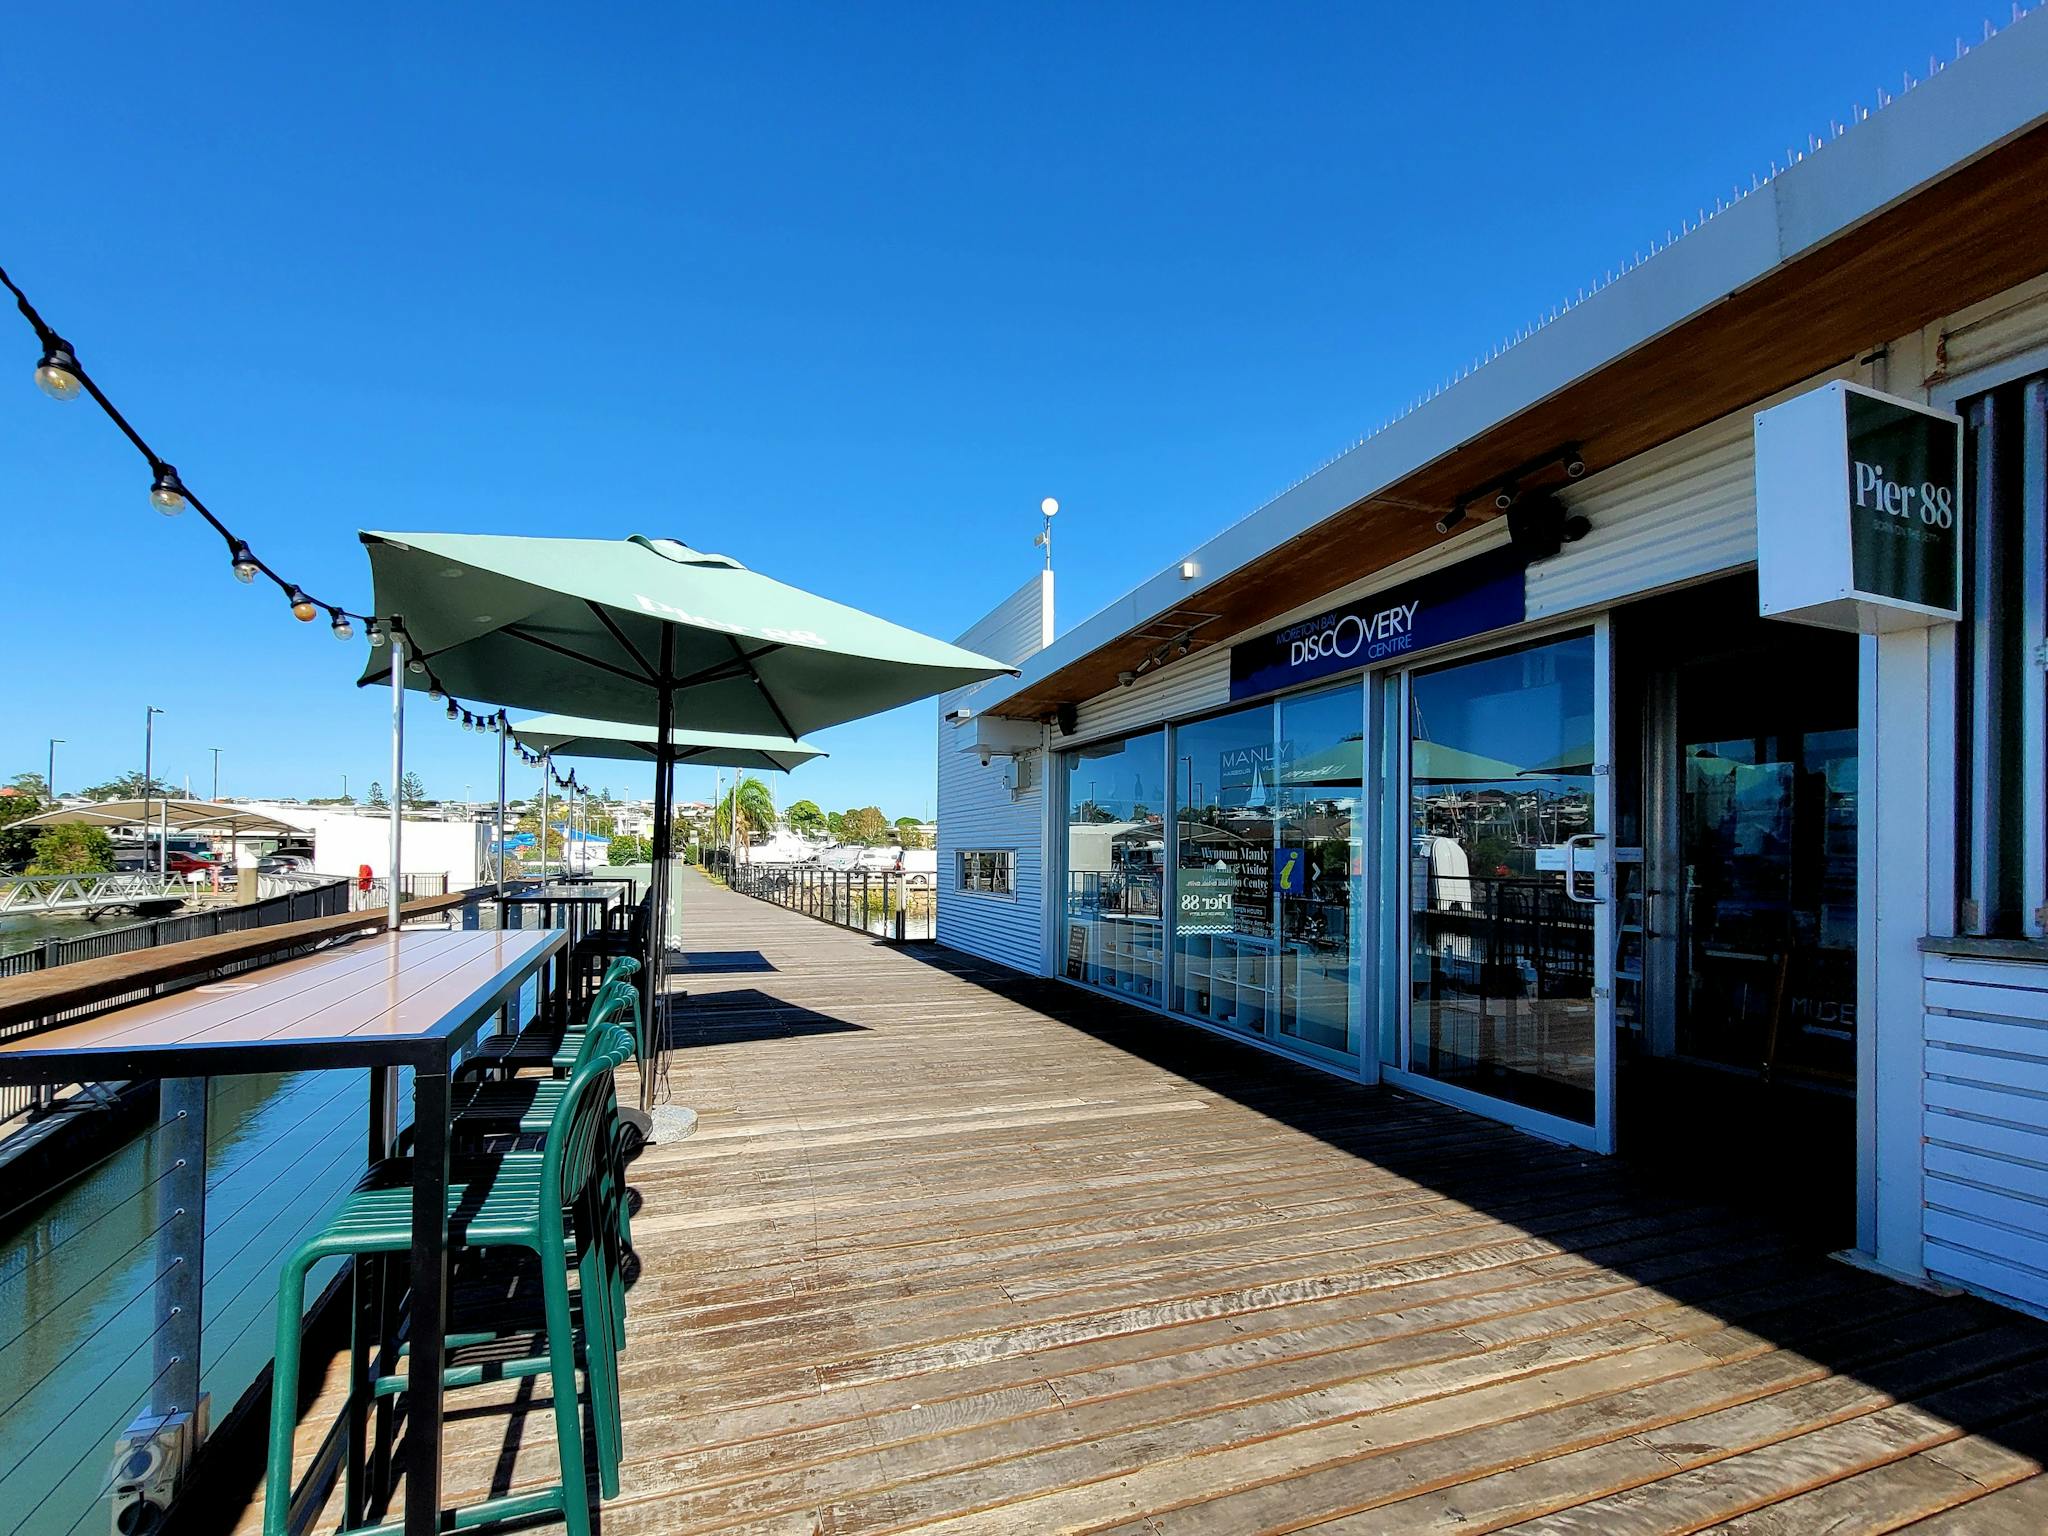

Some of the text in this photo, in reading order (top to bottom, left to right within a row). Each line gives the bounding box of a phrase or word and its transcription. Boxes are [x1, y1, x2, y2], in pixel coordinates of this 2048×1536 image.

[1854, 461, 1952, 529] Pier 88
[1276, 613, 1338, 645] MORETON BAY
[1291, 600, 1419, 667] DISCOVERY
[1368, 633, 1412, 659] CENTRE
[1222, 742, 1290, 768] MANLY
[1201, 846, 1270, 864] Wynnum Manly
[1240, 863, 1268, 876] Visitor
[1243, 877, 1268, 890] Centre
